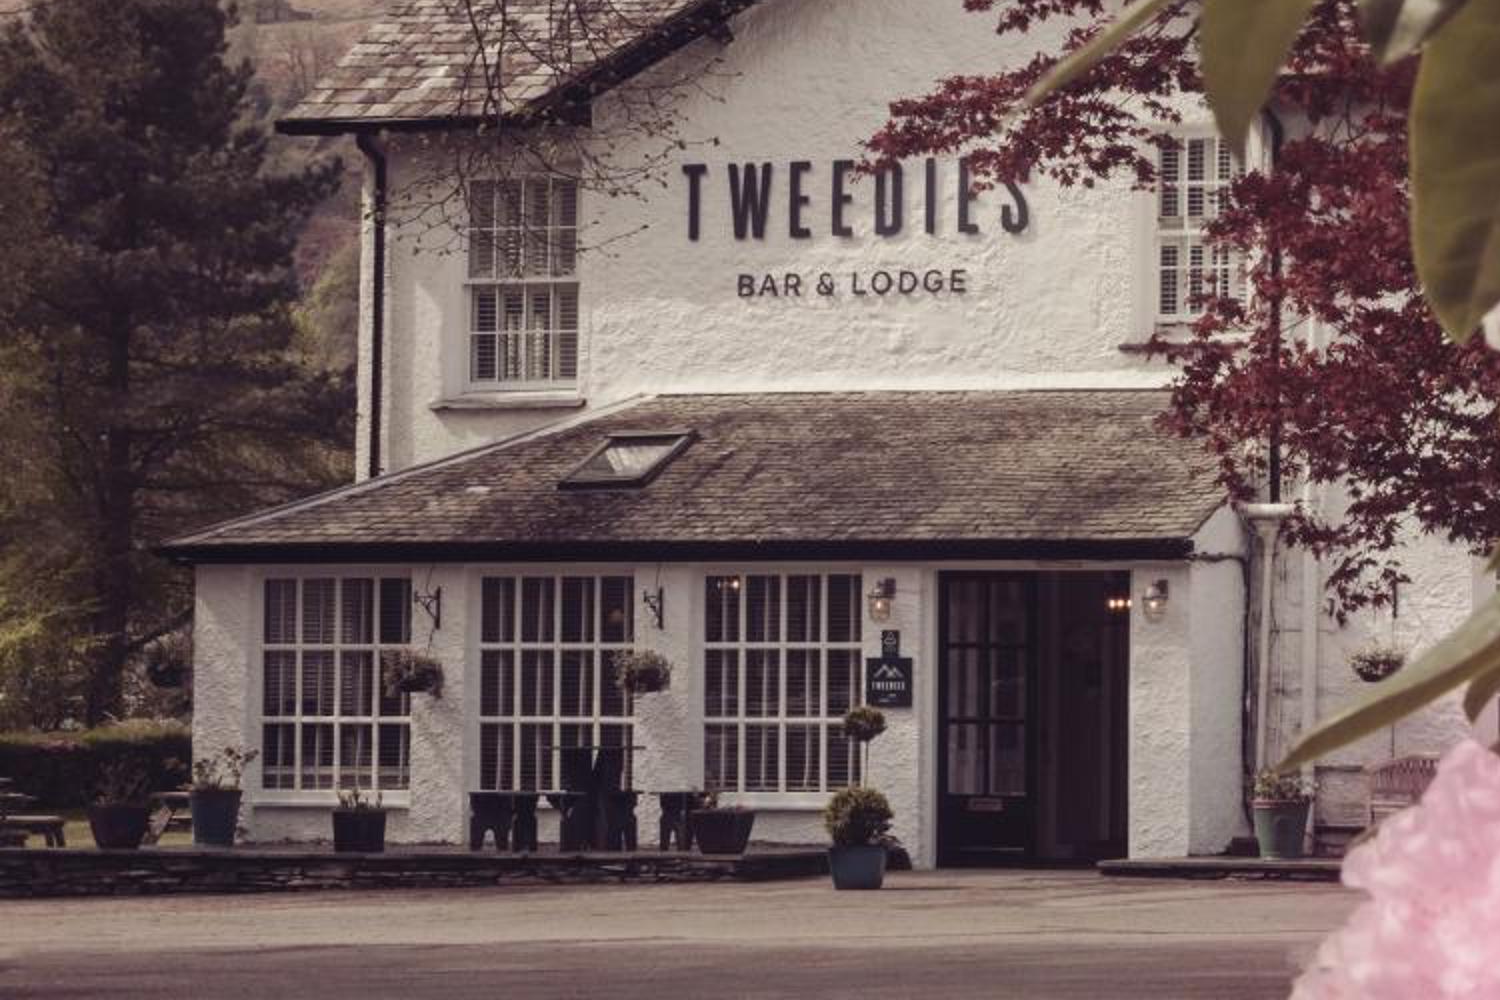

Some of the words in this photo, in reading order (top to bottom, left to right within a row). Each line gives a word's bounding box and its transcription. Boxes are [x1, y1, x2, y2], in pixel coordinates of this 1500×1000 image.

[737, 273, 801, 297] BAR
[816, 273, 835, 296] &
[852, 269, 967, 295] LODGE
